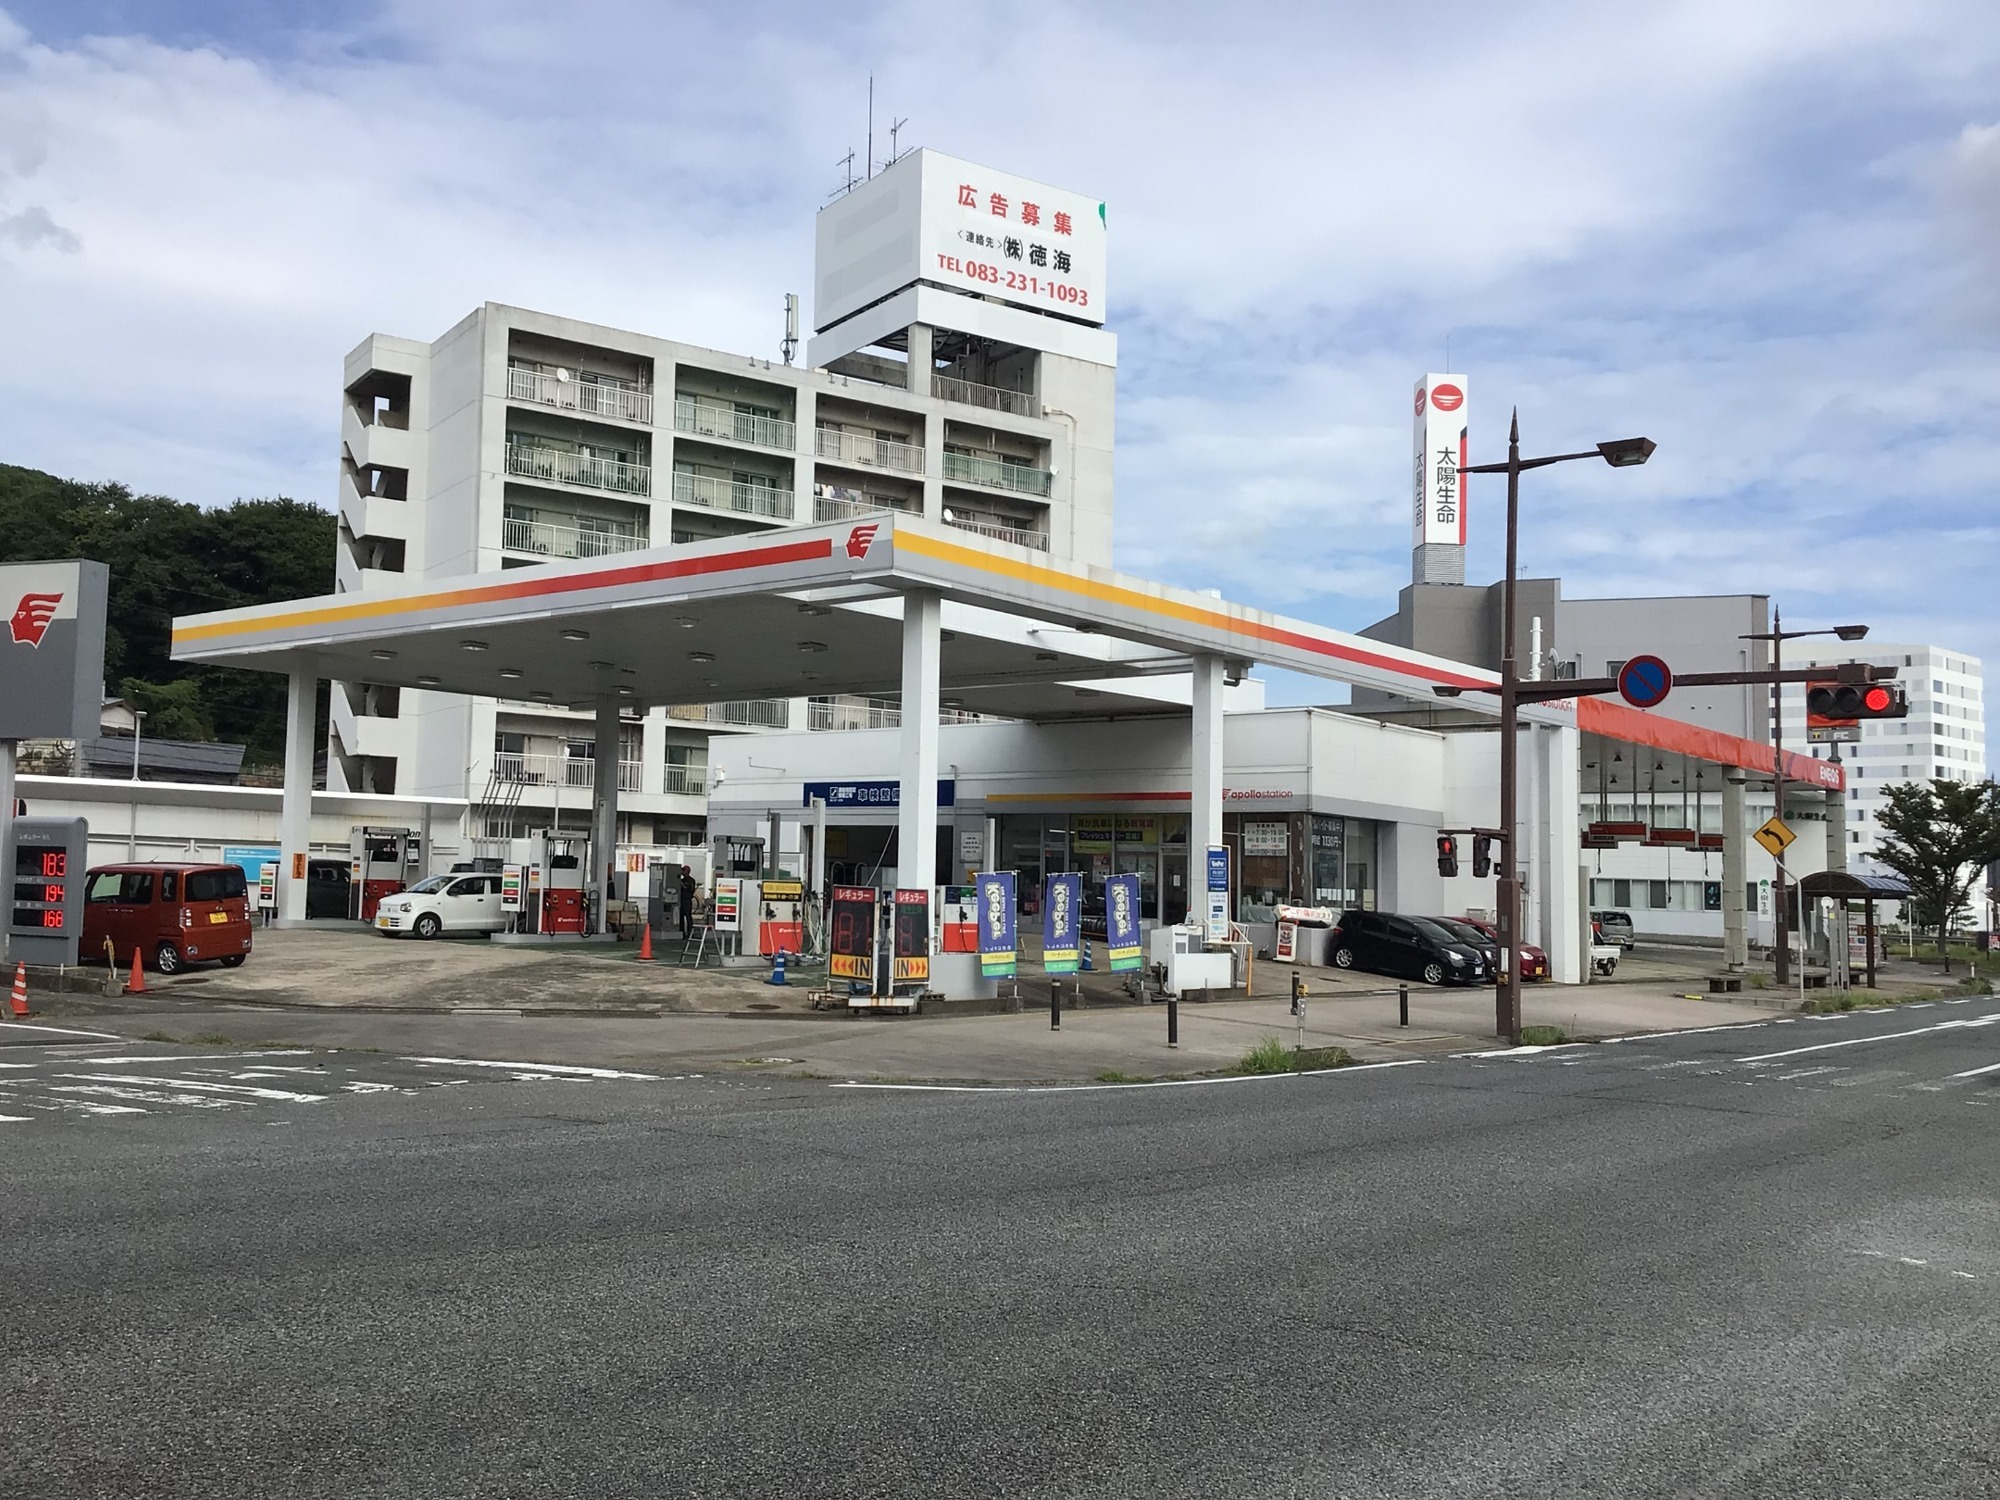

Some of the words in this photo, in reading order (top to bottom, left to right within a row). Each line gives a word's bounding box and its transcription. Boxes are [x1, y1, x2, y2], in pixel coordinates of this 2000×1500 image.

[958, 184, 1072, 236] 広告募集
[937, 254, 963, 274] TEL
[966, 260, 1088, 307] 083-231-1093
[1436, 446, 1456, 524] 太陽生命
[1820, 765, 1840, 784] ENEOS
[1231, 789, 1293, 800] apollostation
[42, 853, 66, 876] 183
[46, 884, 65, 902] 194
[838, 890, 870, 900] レギュラー
[900, 892, 925, 902] レギュラー
[44, 910, 63, 928] 168
[855, 958, 870, 977] IN
[897, 959, 909, 977] IN
